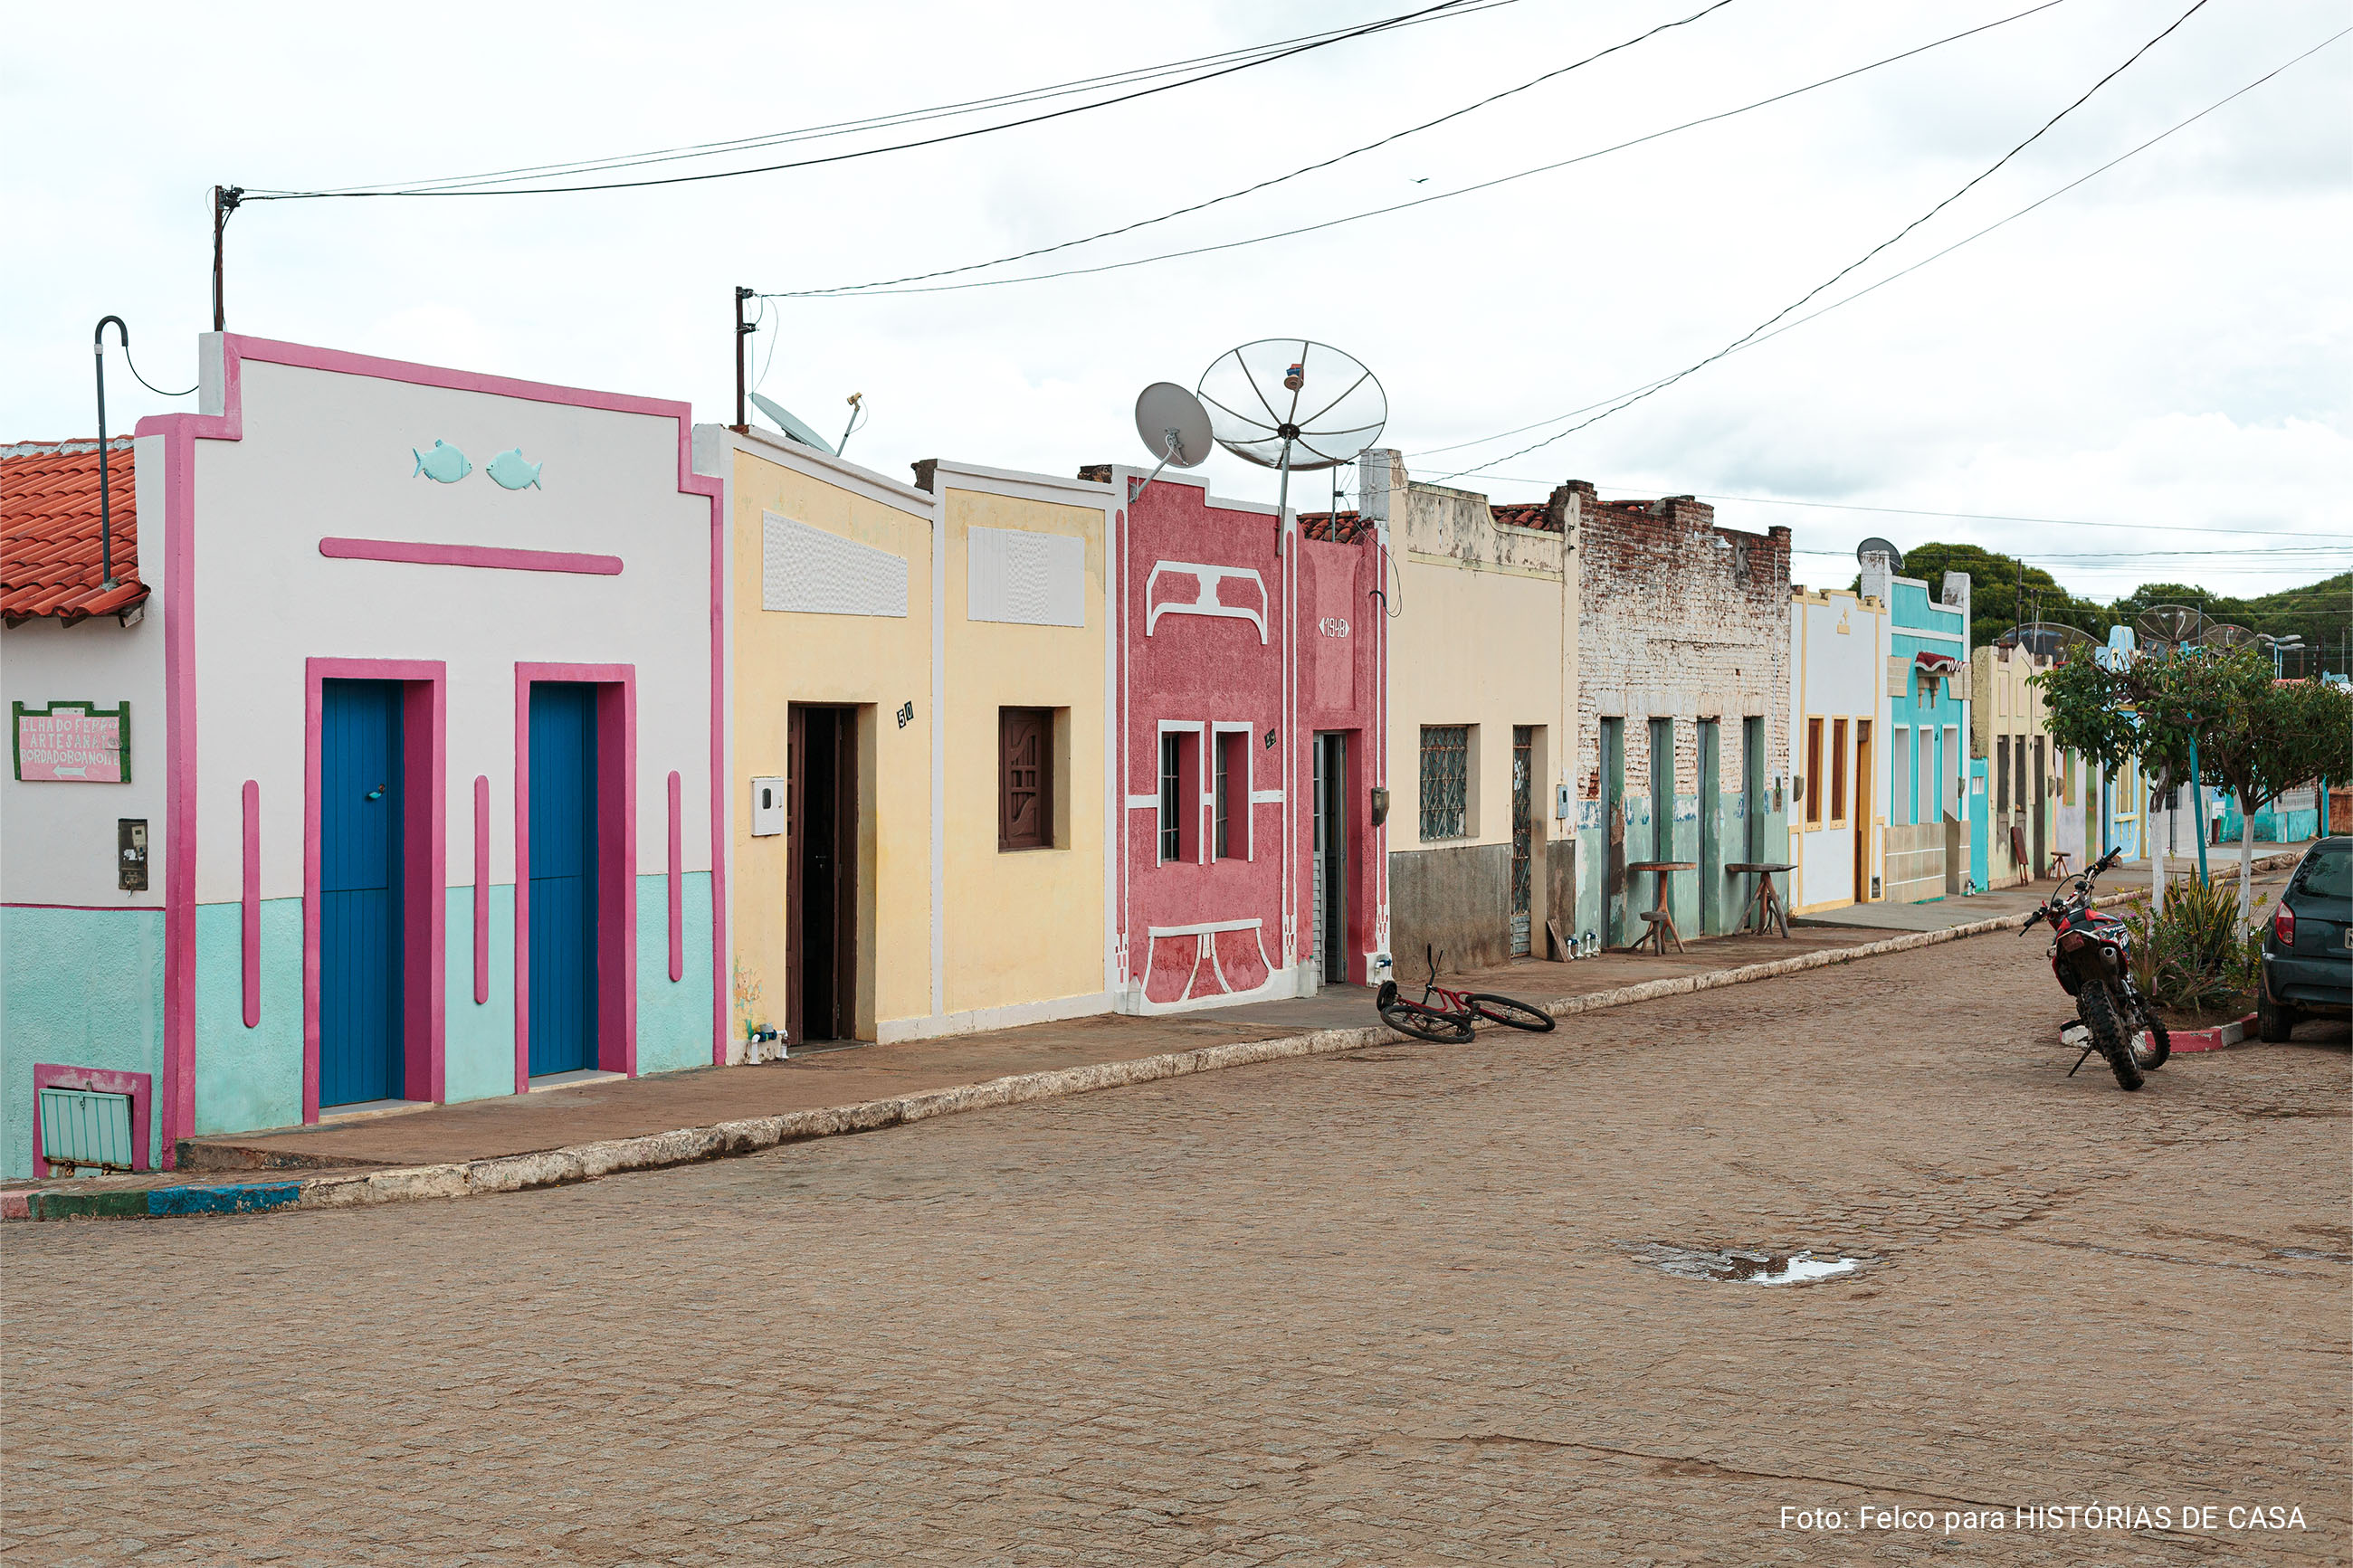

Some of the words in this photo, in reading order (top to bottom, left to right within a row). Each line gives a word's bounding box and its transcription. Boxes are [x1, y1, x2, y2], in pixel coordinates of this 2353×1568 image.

[1325, 617, 1345, 637] 1948
[898, 702, 913, 728] 50
[21, 718, 53, 732] ILHA
[56, 718, 72, 732] DO
[75, 718, 118, 735] FERRO
[30, 733, 118, 749] ARTESANATO
